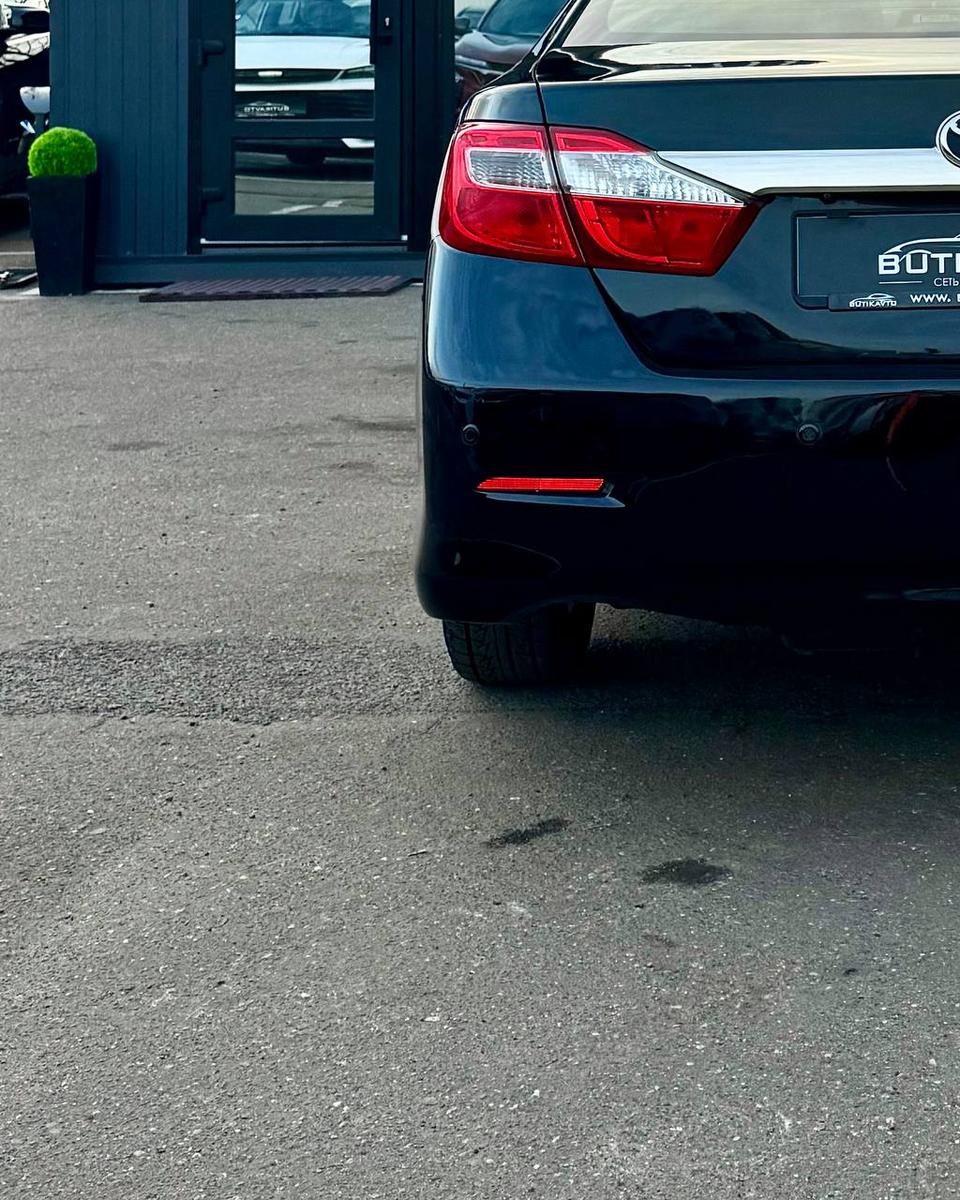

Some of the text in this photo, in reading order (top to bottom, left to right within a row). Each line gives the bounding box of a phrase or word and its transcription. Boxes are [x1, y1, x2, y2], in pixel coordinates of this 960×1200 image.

[933, 276, 959, 287] СЕТЬ
[909, 292, 952, 303] WWW.
[849, 299, 897, 308] BUTIKAVTO
